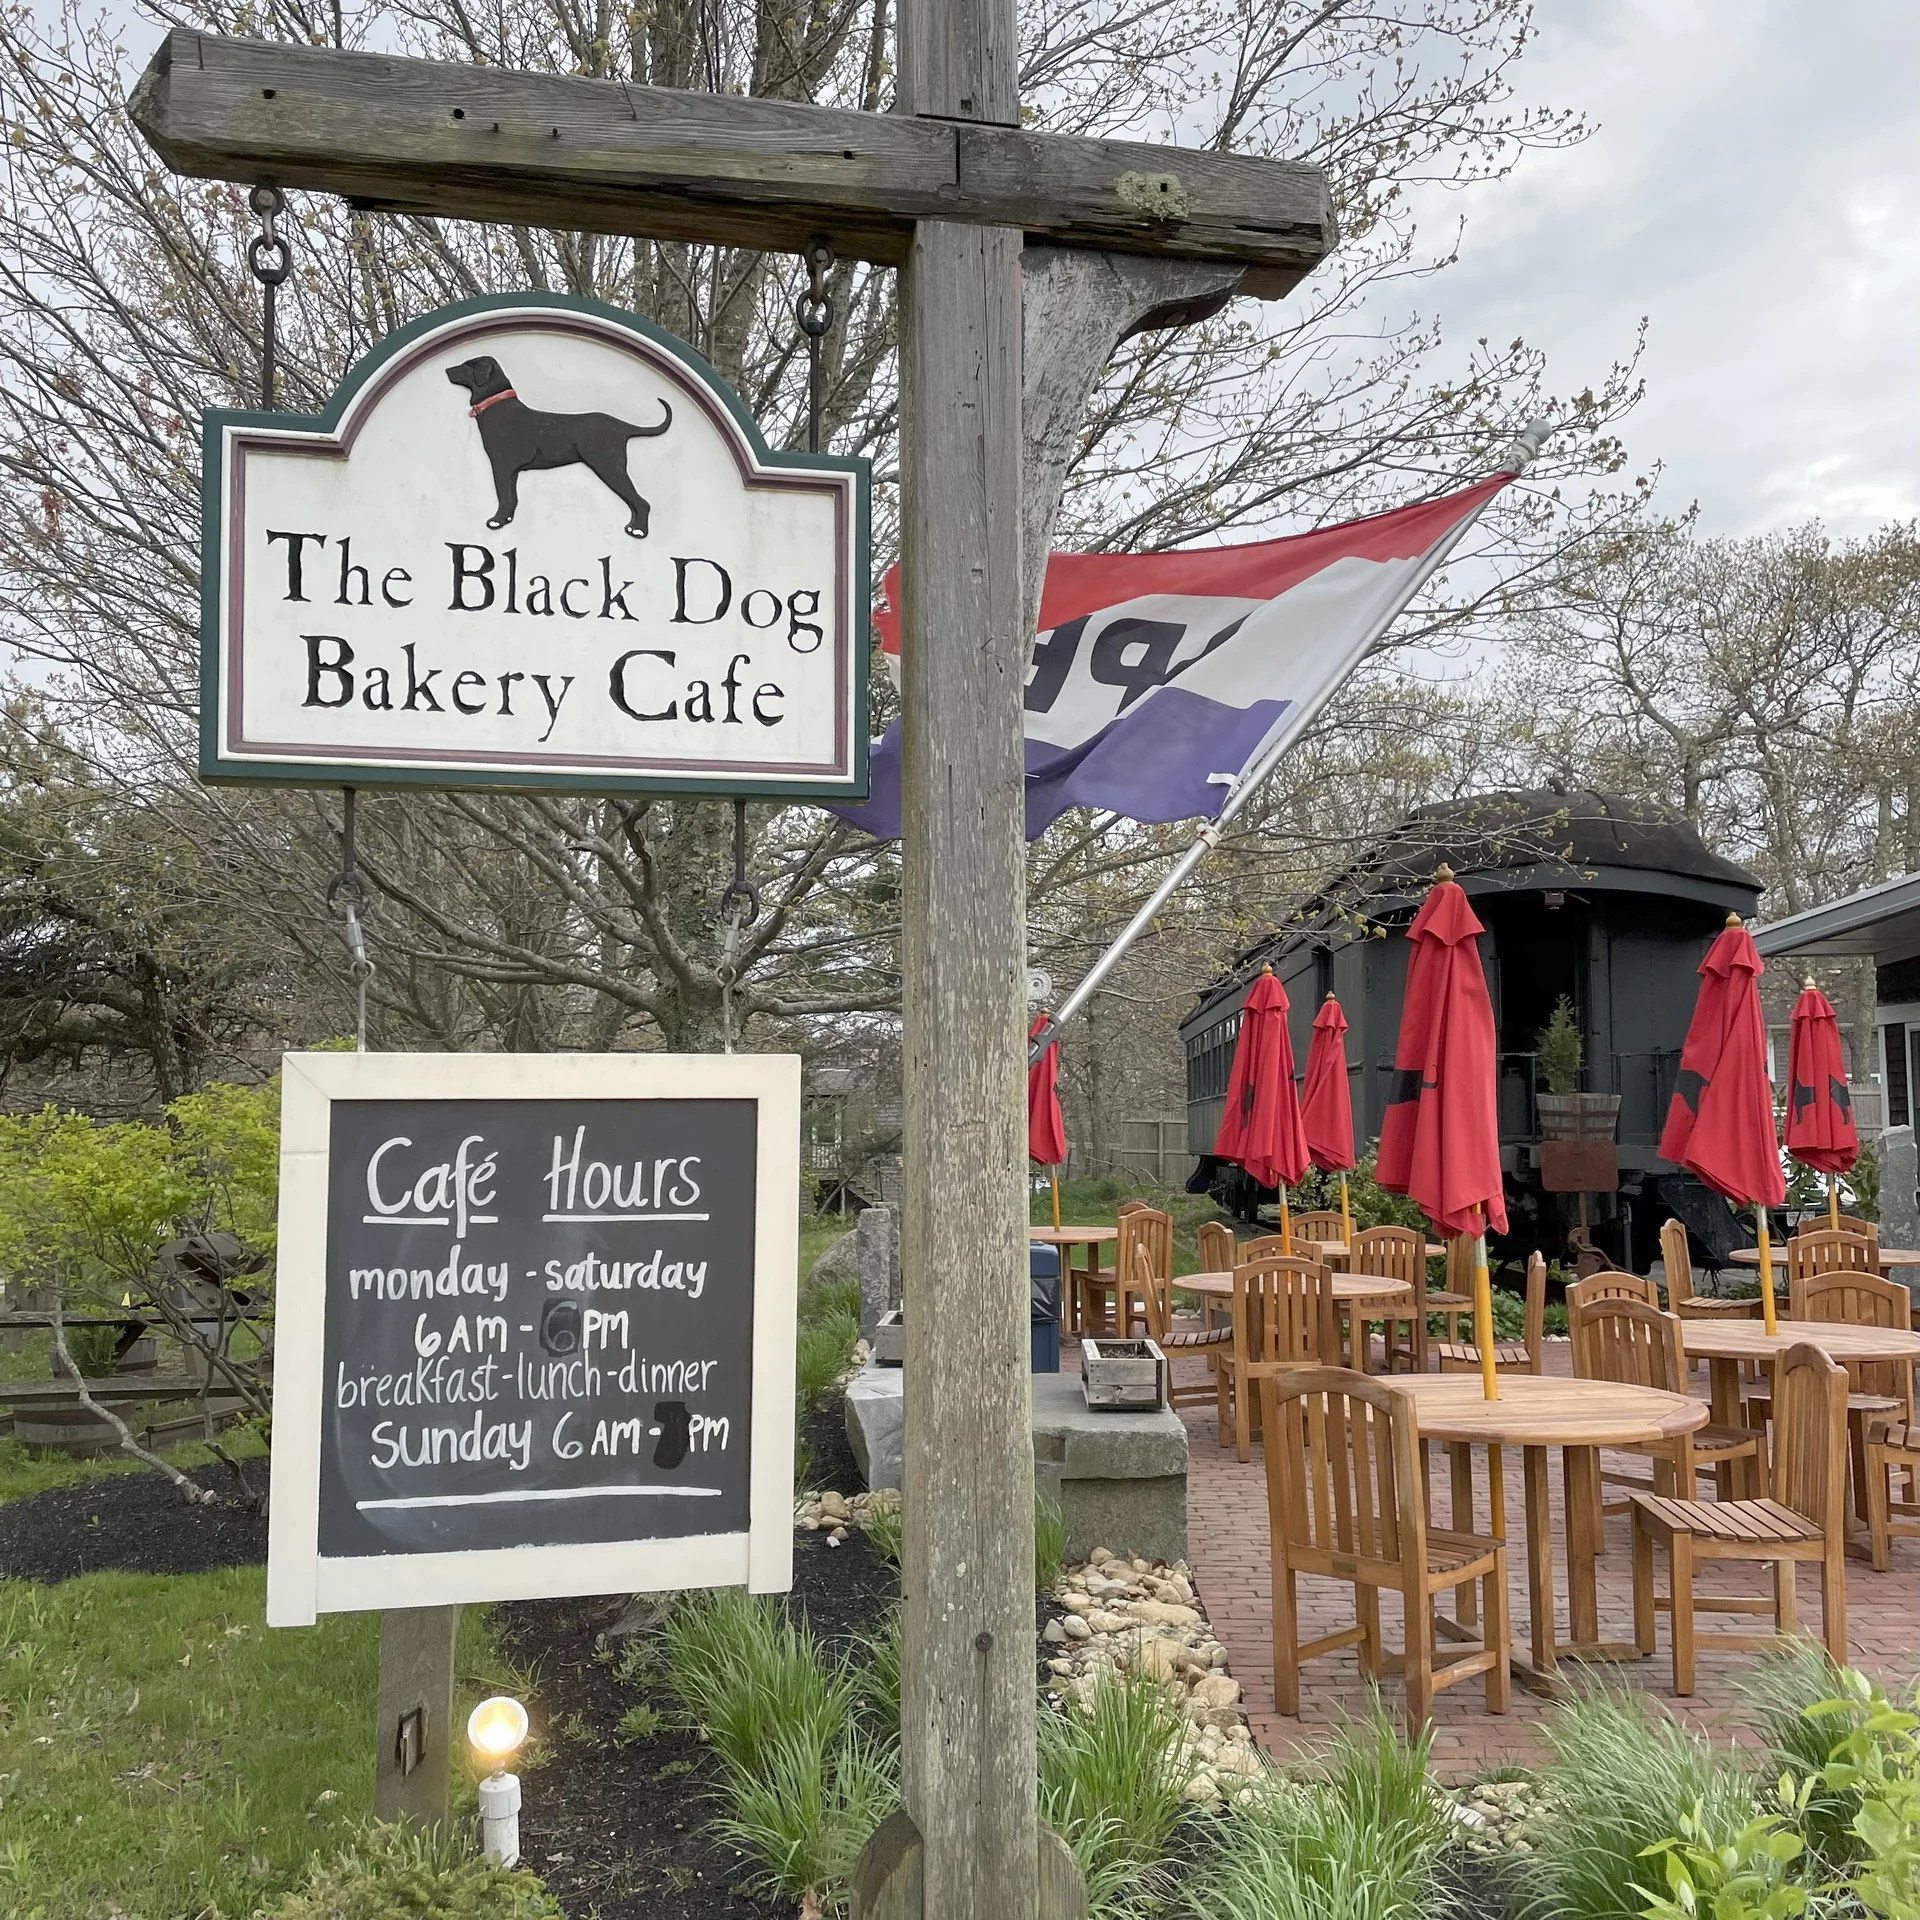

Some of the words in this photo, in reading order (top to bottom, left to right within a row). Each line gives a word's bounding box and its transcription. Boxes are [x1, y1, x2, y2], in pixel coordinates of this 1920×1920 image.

[266, 528, 413, 609] The
[444, 542, 640, 622] Black
[669, 557, 824, 654] Dog
[299, 634, 576, 743] Bakery
[609, 649, 785, 727] Cafe
[366, 1135, 499, 1239] Café
[542, 1124, 701, 1211] Hours
[349, 1243, 509, 1303] monday
[370, 1409, 532, 1471] Sunday
